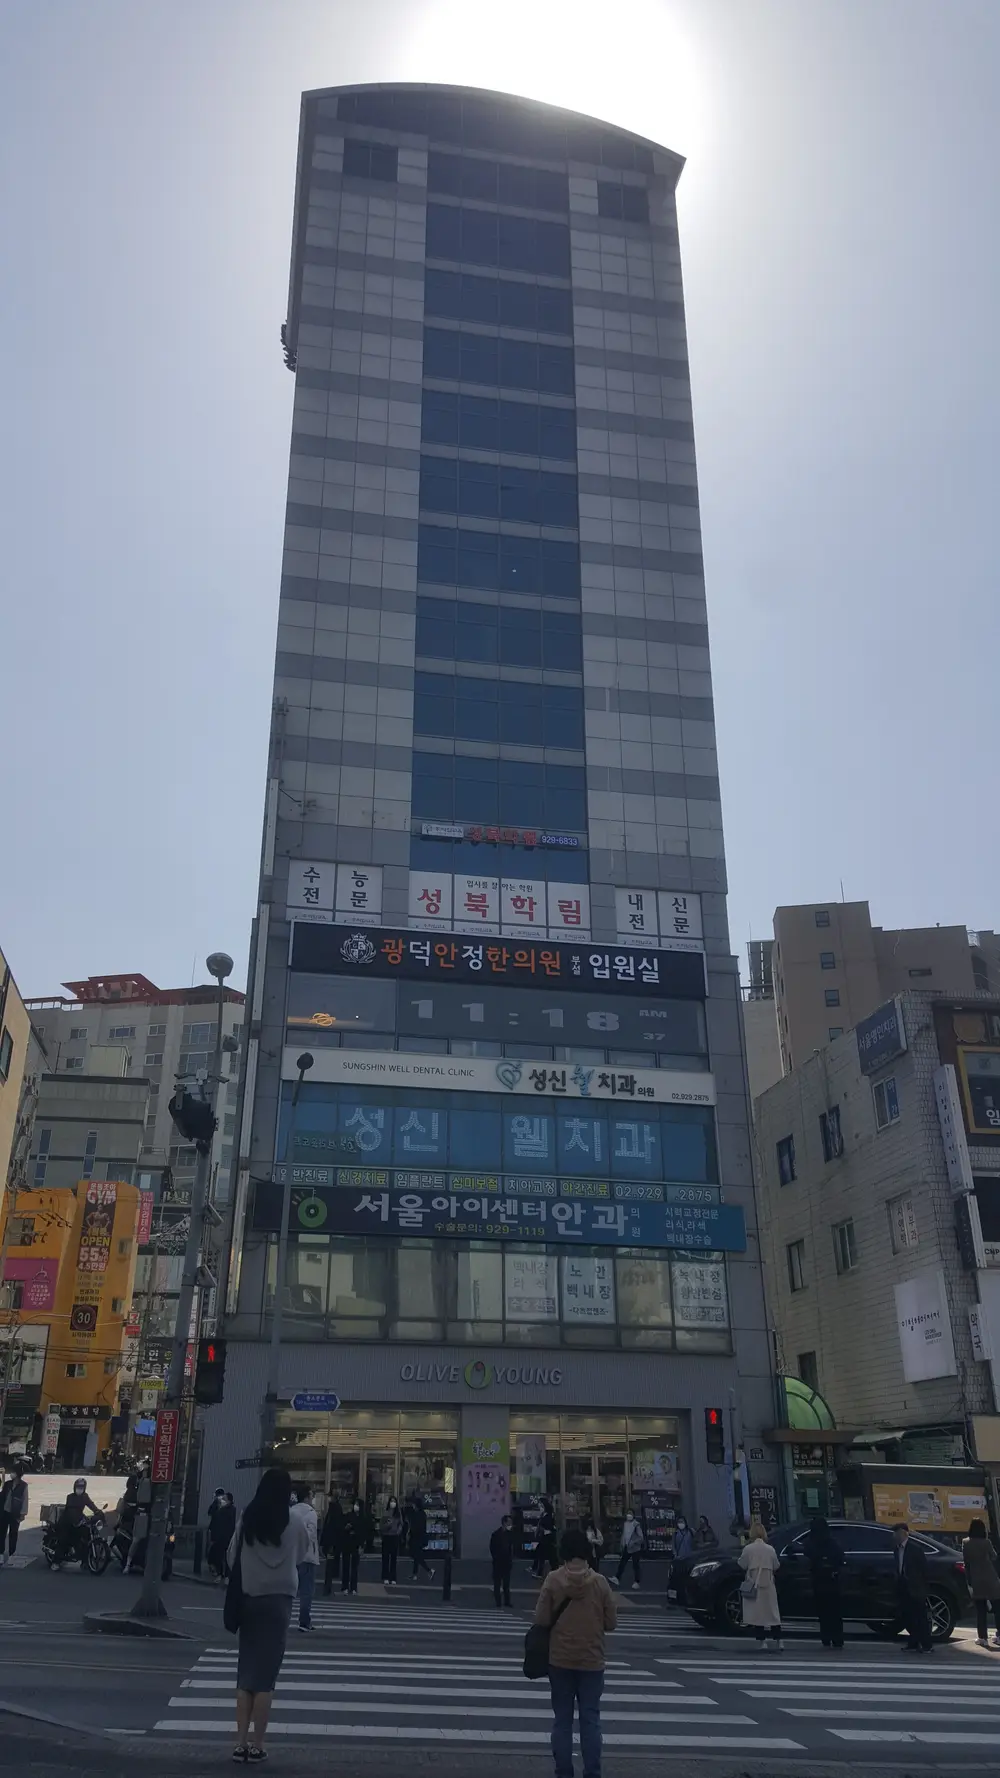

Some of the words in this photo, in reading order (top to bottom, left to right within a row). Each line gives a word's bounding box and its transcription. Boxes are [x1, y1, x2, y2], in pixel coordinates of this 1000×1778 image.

[541, 835, 578, 846] 929-6833
[417, 888, 581, 925] 성북학림
[380, 938, 561, 976] 광덕안정한의원
[588, 954, 660, 983] 입원실
[342, 1062, 386, 1072] SUNGSHIN
[388, 1065, 411, 1074] WELL
[413, 1066, 445, 1076] DENTAL
[448, 1068, 475, 1078] CLINIC
[529, 1064, 637, 1096] 성신웰치과
[637, 1086, 655, 1097] 의원
[672, 1092, 709, 1102] 02.929.2875
[345, 1107, 439, 1152] 성신
[339, 1171, 386, 1185] 신경치료
[397, 1174, 444, 1189] 임플란트
[452, 1176, 498, 1191] 심미보철
[508, 1179, 555, 1194] 치아교정
[562, 1182, 609, 1197] 야간진료
[615, 1185, 662, 1200] 02.929
[88, 1190, 117, 1205] GYM
[665, 1207, 719, 1220] 시력교정전문
[486, 1224, 545, 1237] 929-1119
[81, 1237, 111, 1247] OPEN
[667, 1233, 712, 1246] 백내장수술
[567, 1284, 611, 1300] 백내장
[77, 1313, 91, 1324] 30
[401, 1363, 459, 1383] OLIVE
[495, 1365, 563, 1385] YOUNG
[156, 1412, 175, 1481] 무단횡단금지
[751, 1488, 775, 1500] 스피닝
